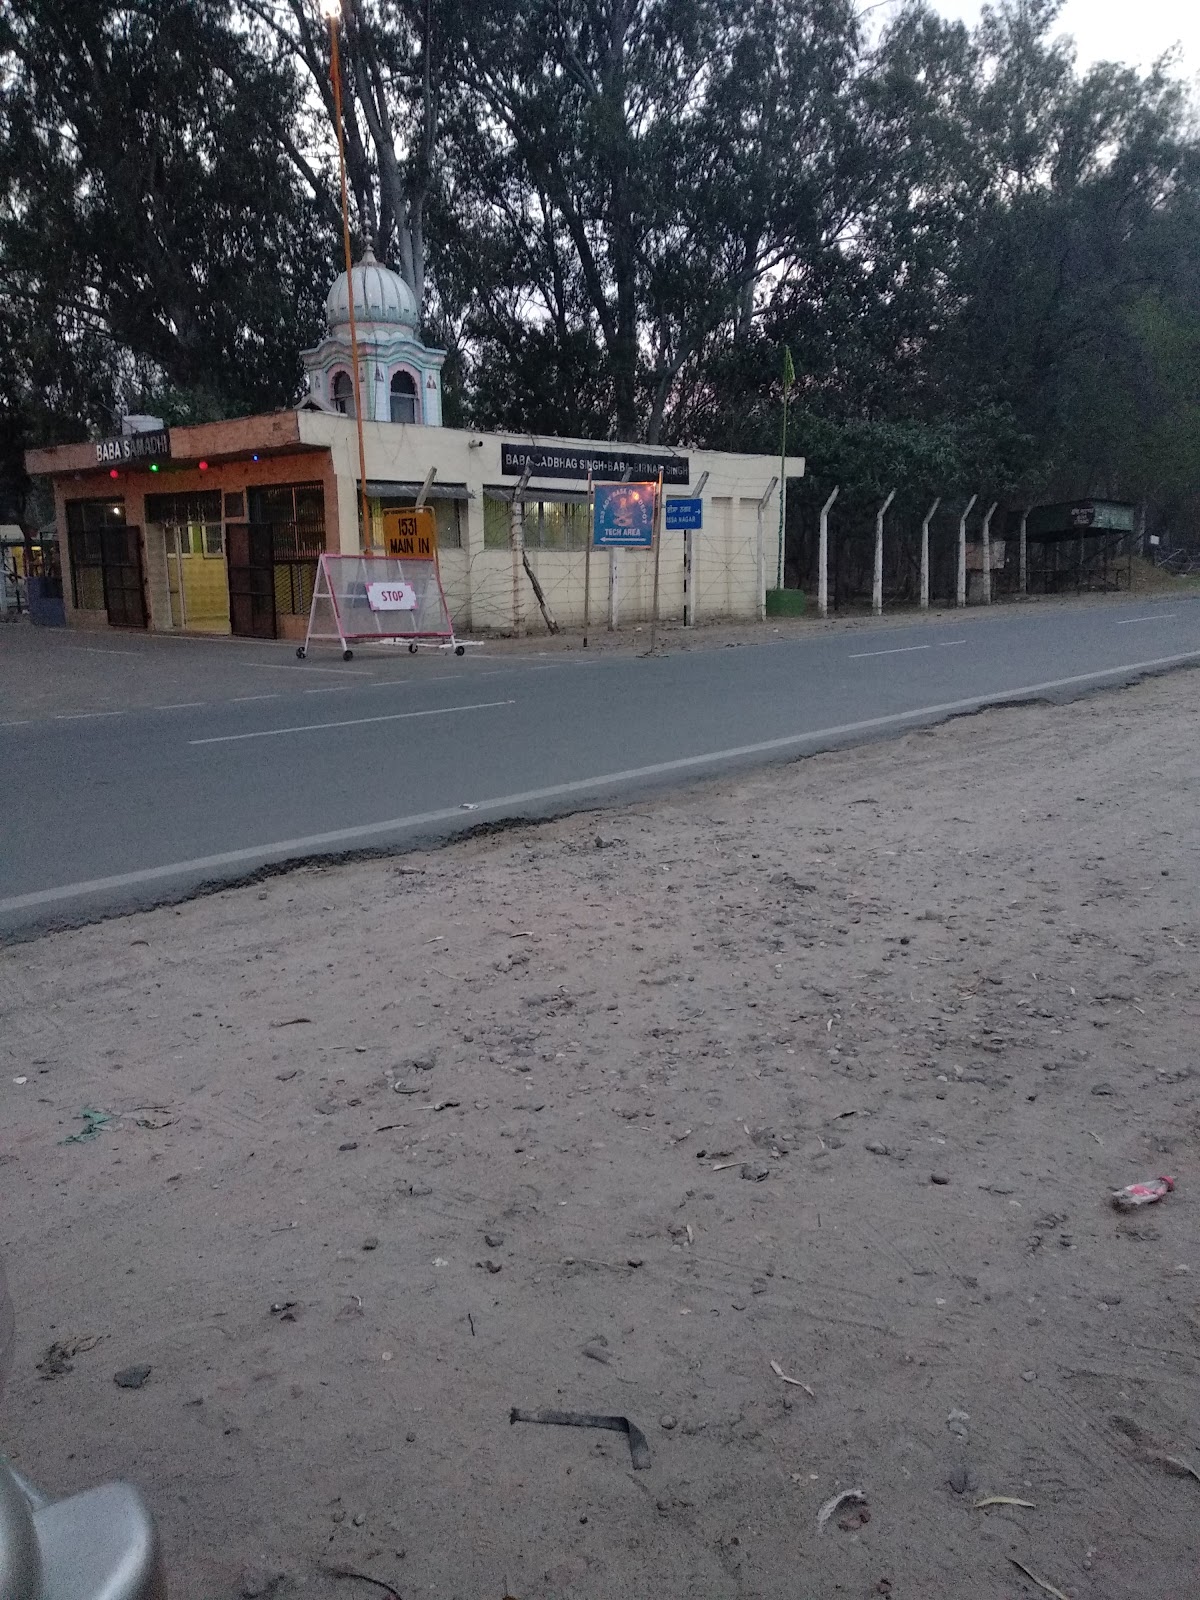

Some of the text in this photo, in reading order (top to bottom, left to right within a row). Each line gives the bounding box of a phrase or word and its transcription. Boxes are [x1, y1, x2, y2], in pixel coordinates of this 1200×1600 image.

[96, 434, 168, 462] BABA SAMADHI
[534, 455, 577, 469] ADBHAG
[665, 466, 688, 475] SINGH
[637, 498, 648, 525] DEPOT
[678, 515, 696, 523] NAGAR
[397, 517, 417, 536] 1531
[604, 528, 641, 536] TECH AREA
[389, 538, 430, 553] MAIN IN
[381, 590, 404, 602] STOP
